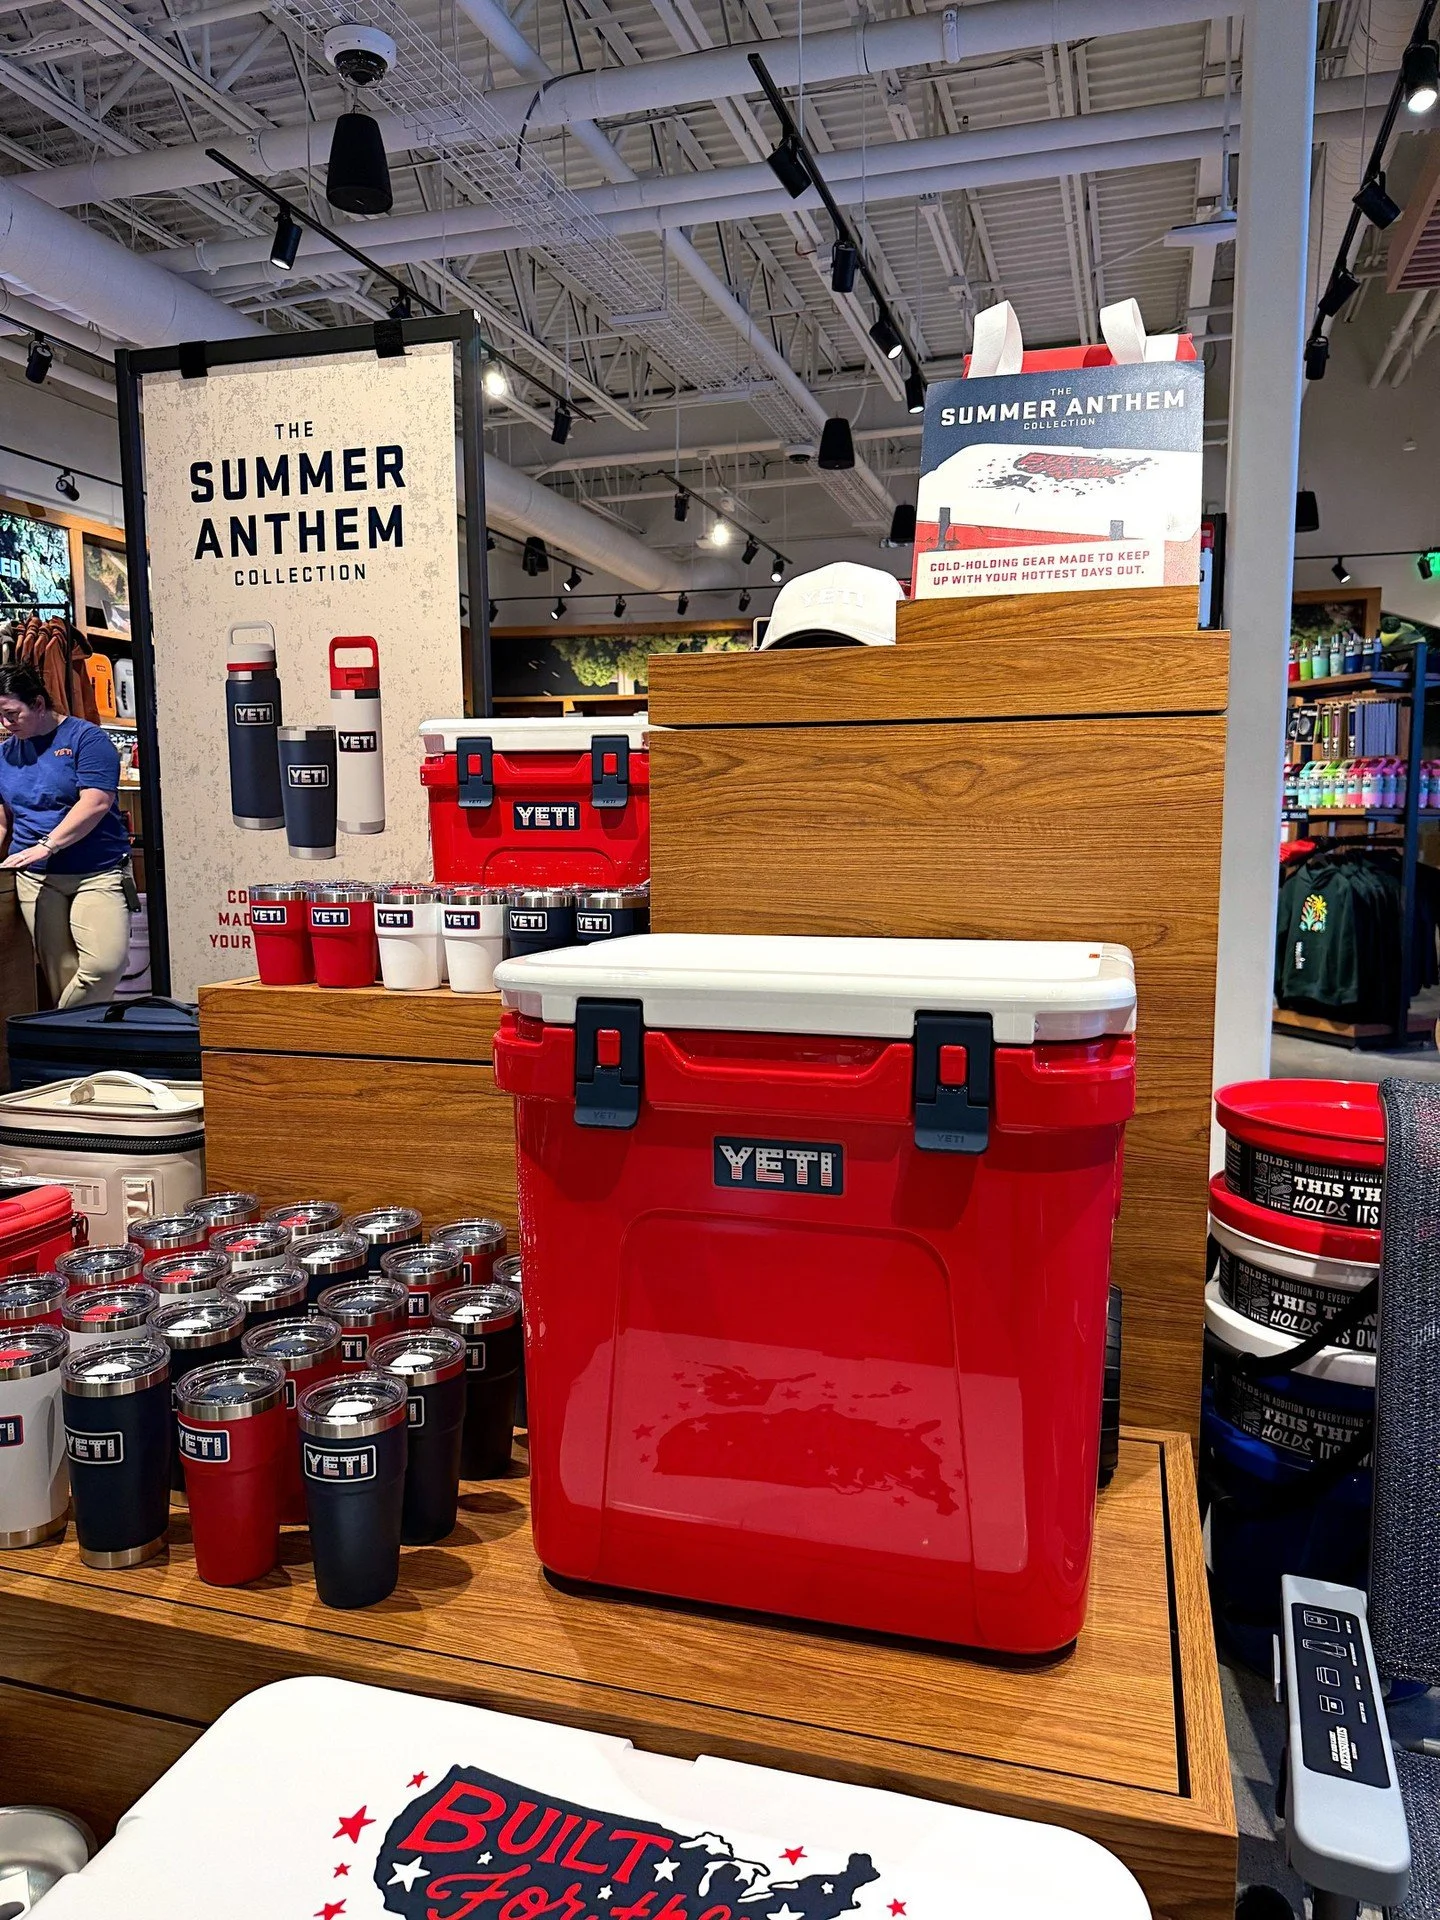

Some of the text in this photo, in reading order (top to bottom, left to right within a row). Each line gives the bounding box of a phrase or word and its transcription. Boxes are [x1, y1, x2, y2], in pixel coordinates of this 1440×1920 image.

[1050, 387, 1072, 396] THE
[940, 389, 1185, 427] SUMMER ANTHEM
[274, 421, 314, 440] THE
[1023, 418, 1096, 430] COLLECTION
[190, 444, 406, 503] SUMMER
[194, 504, 404, 560] ANTHEM
[930, 550, 1150, 573] COLD-HOLDING GEAR MADE TO KEEP
[234, 563, 366, 586] COLLECTION
[933, 565, 1145, 586] UP WITH YOUR HOTTEST DAYS OUT.
[238, 706, 271, 721] YETI
[340, 735, 375, 749] YETI
[291, 769, 326, 784] YETI
[516, 806, 576, 827] YETI
[253, 909, 281, 921] YETI
[314, 911, 344, 923] YETI
[379, 912, 408, 924] YETI
[446, 914, 475, 926] YETI
[512, 915, 542, 928] YETI
[578, 916, 608, 930] YETI
[209, 934, 252, 948] YOUR
[936, 1133, 965, 1144] YETI
[719, 1144, 833, 1187] YETI
[1255, 1152, 1293, 1169] HOLDS:
[1294, 1162, 1302, 1173] IN
[1304, 1164, 1339, 1179] ADDITION
[1342, 1170, 1352, 1181] TO
[1293, 1176, 1344, 1198] THIS
[1292, 1195, 1379, 1225] HOLDS ITS
[1238, 1263, 1271, 1284] HOLDS:
[1272, 1277, 1279, 1288] IN
[1280, 1281, 1313, 1297] ADDITION
[1315, 1290, 1325, 1300] TO
[1271, 1291, 1317, 1316] THIS
[1270, 1310, 1323, 1334] HOLDS
[1272, 1396, 1304, 1415] ADDITION
[1306, 1407, 1315, 1418] TO
[1317, 1410, 1364, 1428] EVERYTHING
[1262, 1405, 1308, 1433] THIS
[1313, 1422, 1359, 1443] THI
[65, 1432, 115, 1459] YETI
[178, 1425, 222, 1457] YETI
[1262, 1424, 1314, 1452] HOLDS
[307, 1451, 368, 1476] YETI
[396, 1780, 675, 1884] BUILT
[426, 1863, 586, 1920] For
